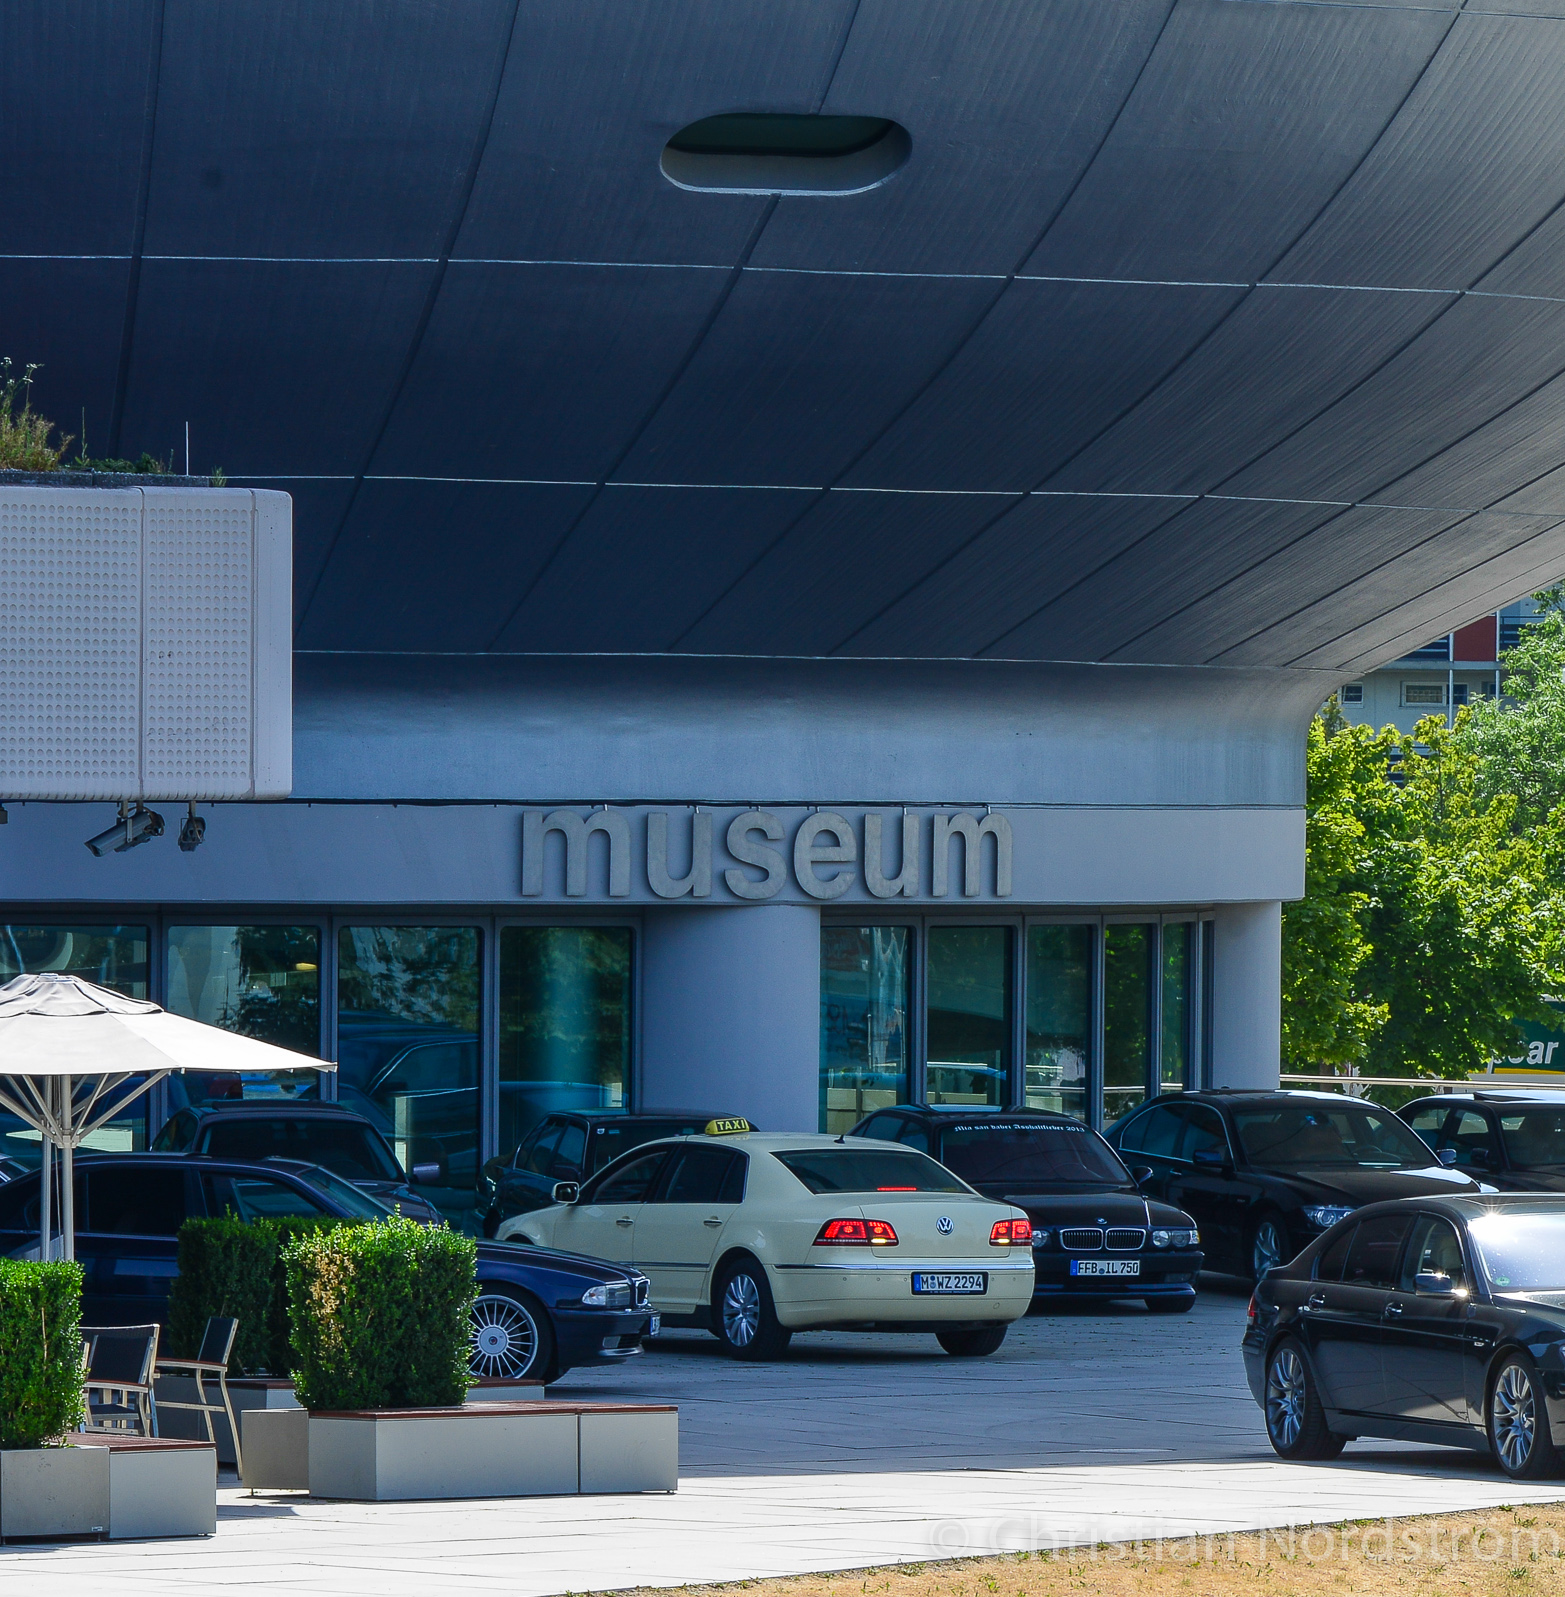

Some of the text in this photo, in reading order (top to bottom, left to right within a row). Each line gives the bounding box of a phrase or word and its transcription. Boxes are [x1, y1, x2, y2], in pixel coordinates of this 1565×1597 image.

[522, 811, 1013, 900] museum
[717, 1120, 746, 1130] TAXI
[1078, 1262, 1098, 1274] FFB
[1105, 1262, 1118, 1274] IL
[1120, 1262, 1139, 1274] 750
[921, 1275, 982, 1289] M WZ 2294
